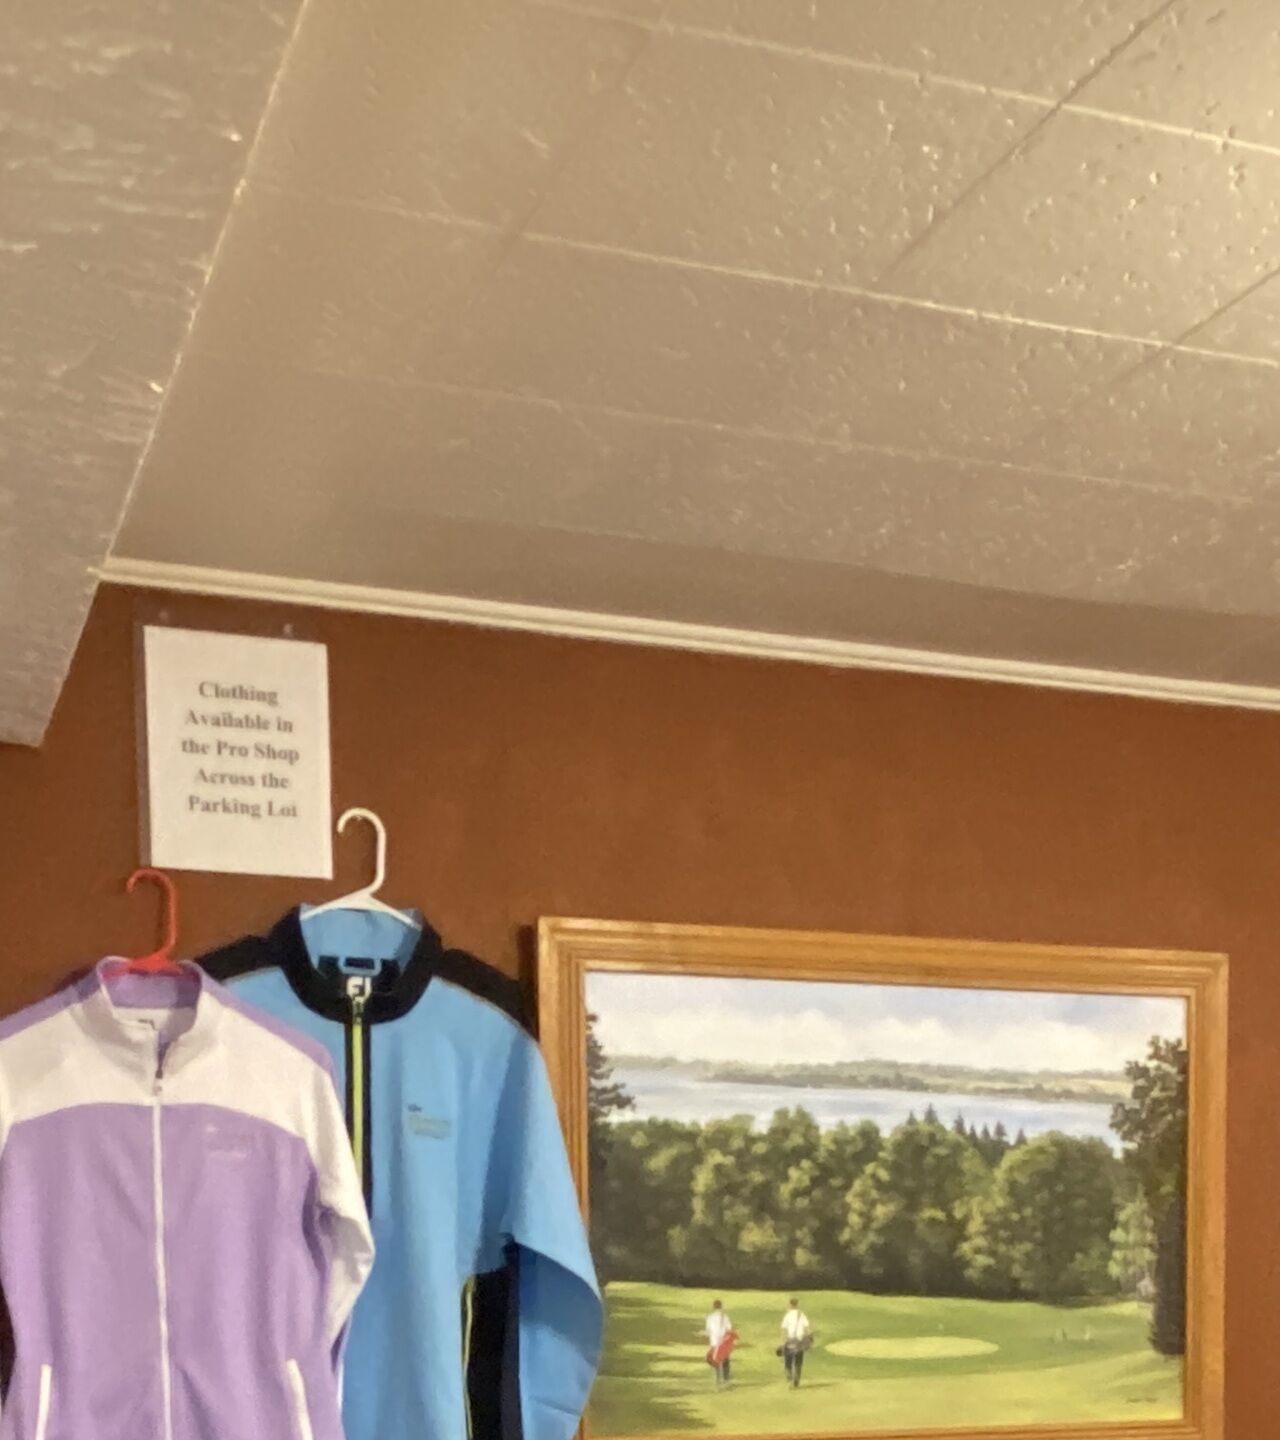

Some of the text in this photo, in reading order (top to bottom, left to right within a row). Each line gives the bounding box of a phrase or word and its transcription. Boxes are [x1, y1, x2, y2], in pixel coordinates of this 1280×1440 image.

[198, 680, 279, 707] Clothing
[185, 709, 294, 733] Available in
[181, 738, 300, 766] the Pro Shop
[195, 768, 289, 789] Across the
[189, 795, 297, 819] Parking Lot
